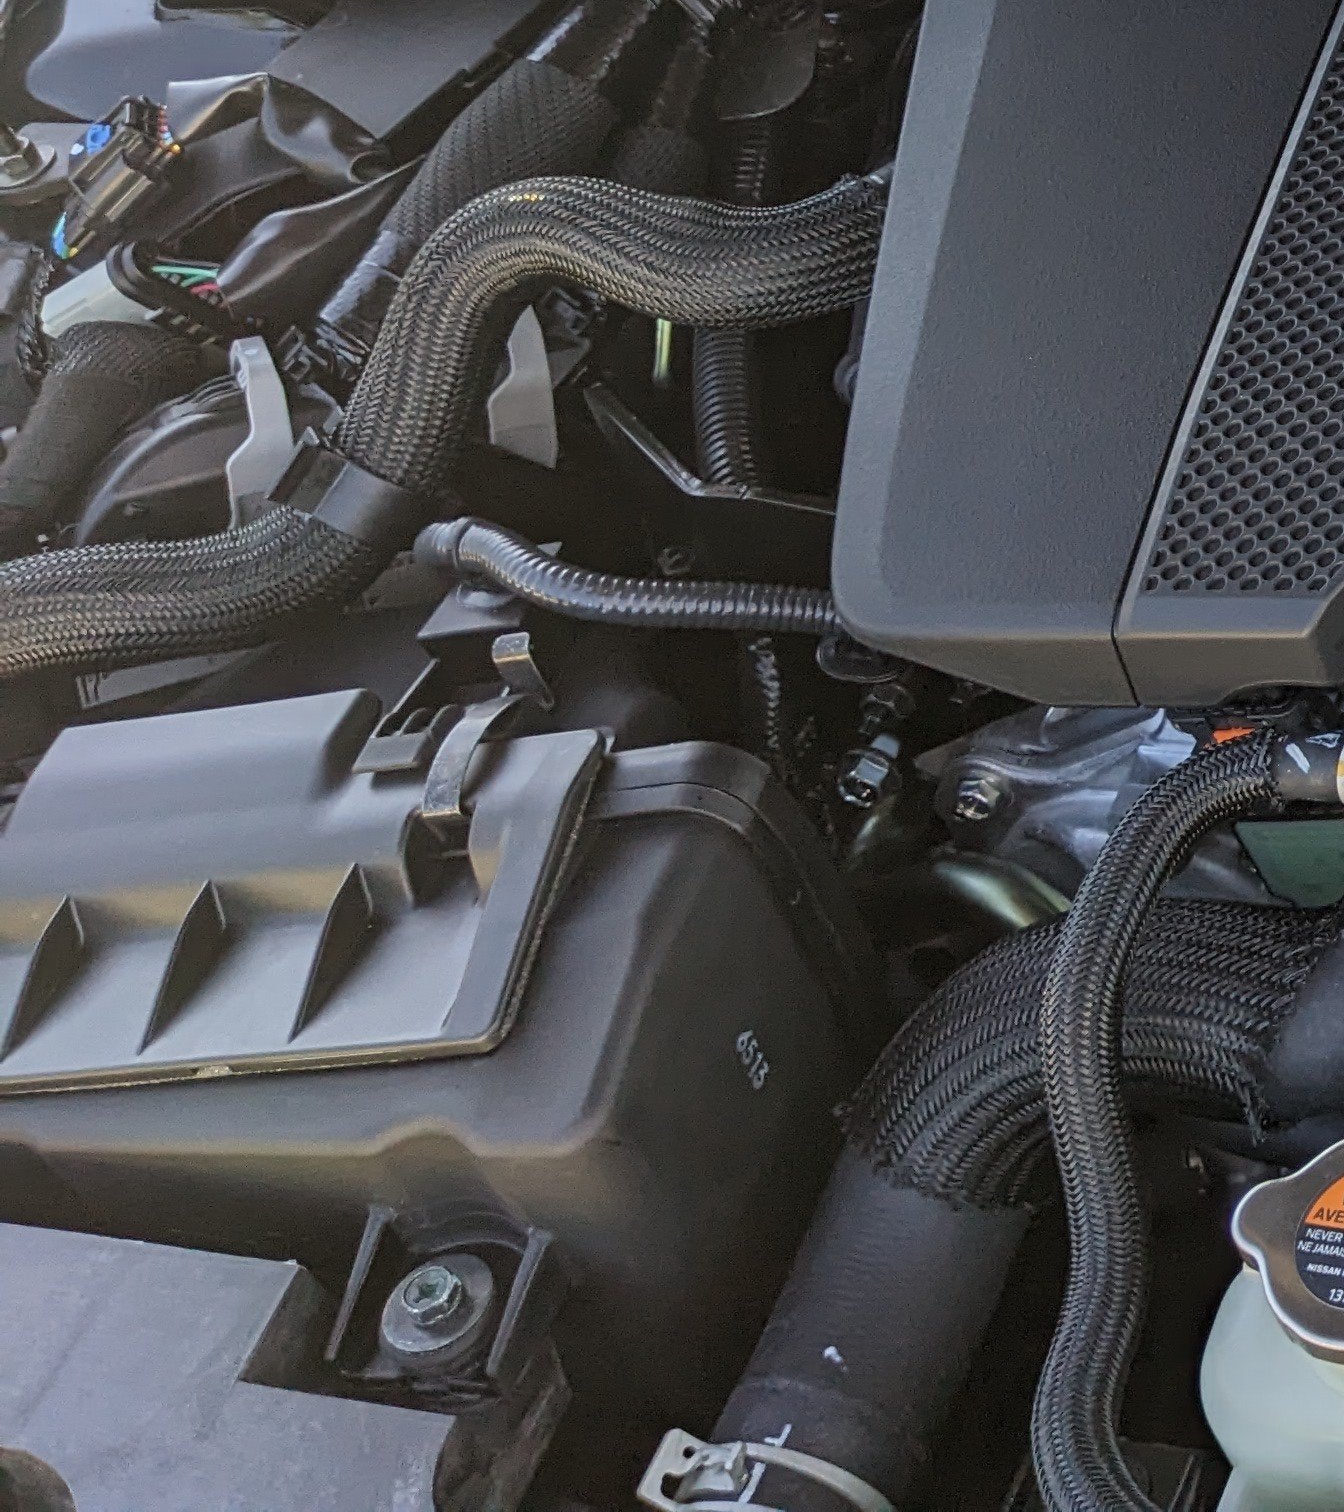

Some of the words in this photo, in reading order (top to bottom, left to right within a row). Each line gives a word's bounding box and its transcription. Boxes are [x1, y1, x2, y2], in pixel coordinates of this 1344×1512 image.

[1305, 1228, 1344, 1243] NEVER
[1297, 1240, 1312, 1252] NE
[1306, 1263, 1342, 1276] NISSAN
